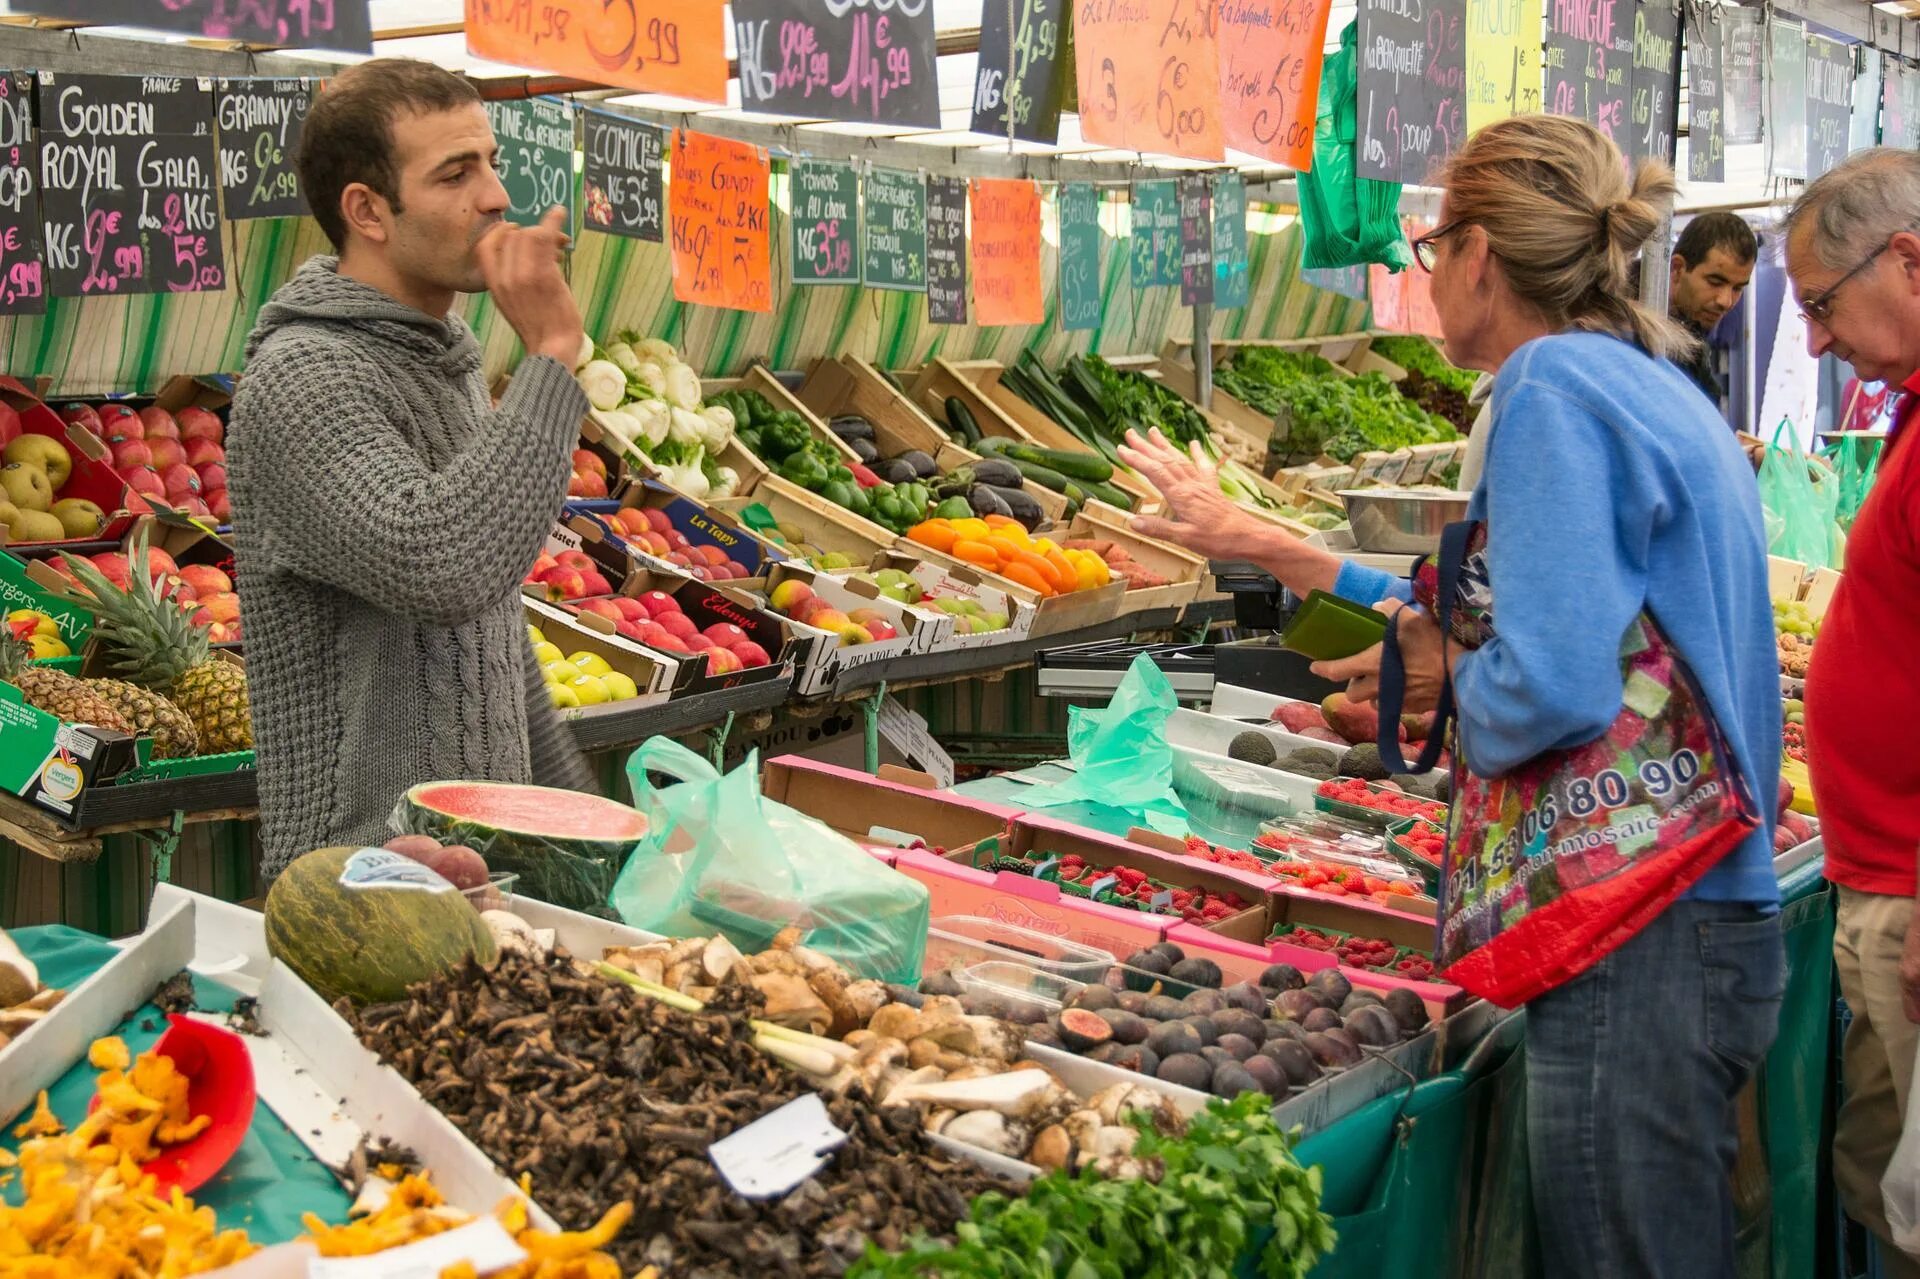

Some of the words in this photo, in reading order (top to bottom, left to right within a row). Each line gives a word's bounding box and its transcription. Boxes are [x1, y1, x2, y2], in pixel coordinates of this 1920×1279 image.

[220, 148, 248, 188] KG
[608, 174, 626, 205] KG
[184, 191, 216, 230] KG
[45, 221, 81, 270] KG
[797, 228, 816, 262] KG
[689, 514, 709, 531] La
[708, 523, 739, 547] Tapy
[1523, 793, 1559, 847] 06
[1566, 768, 1629, 817] 80
[1638, 748, 1700, 798] 90
